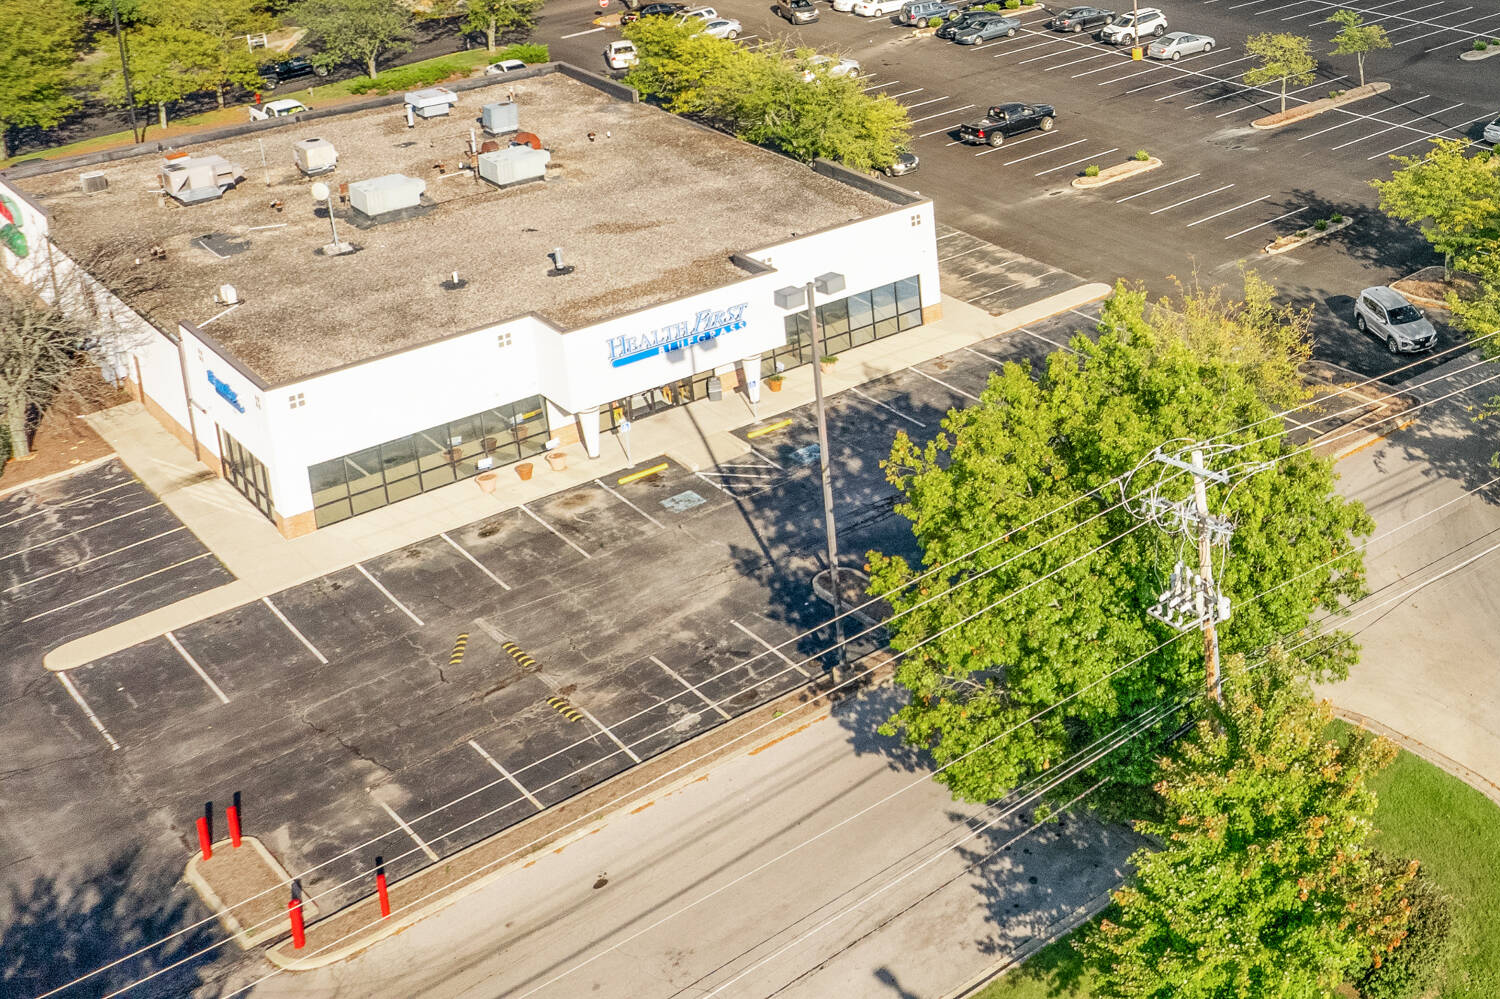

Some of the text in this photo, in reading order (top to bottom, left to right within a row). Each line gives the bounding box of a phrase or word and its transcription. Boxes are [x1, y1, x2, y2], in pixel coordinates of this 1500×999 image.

[606, 302, 749, 360] HEALTH FIRST
[659, 320, 747, 354] BLUEGRASS
